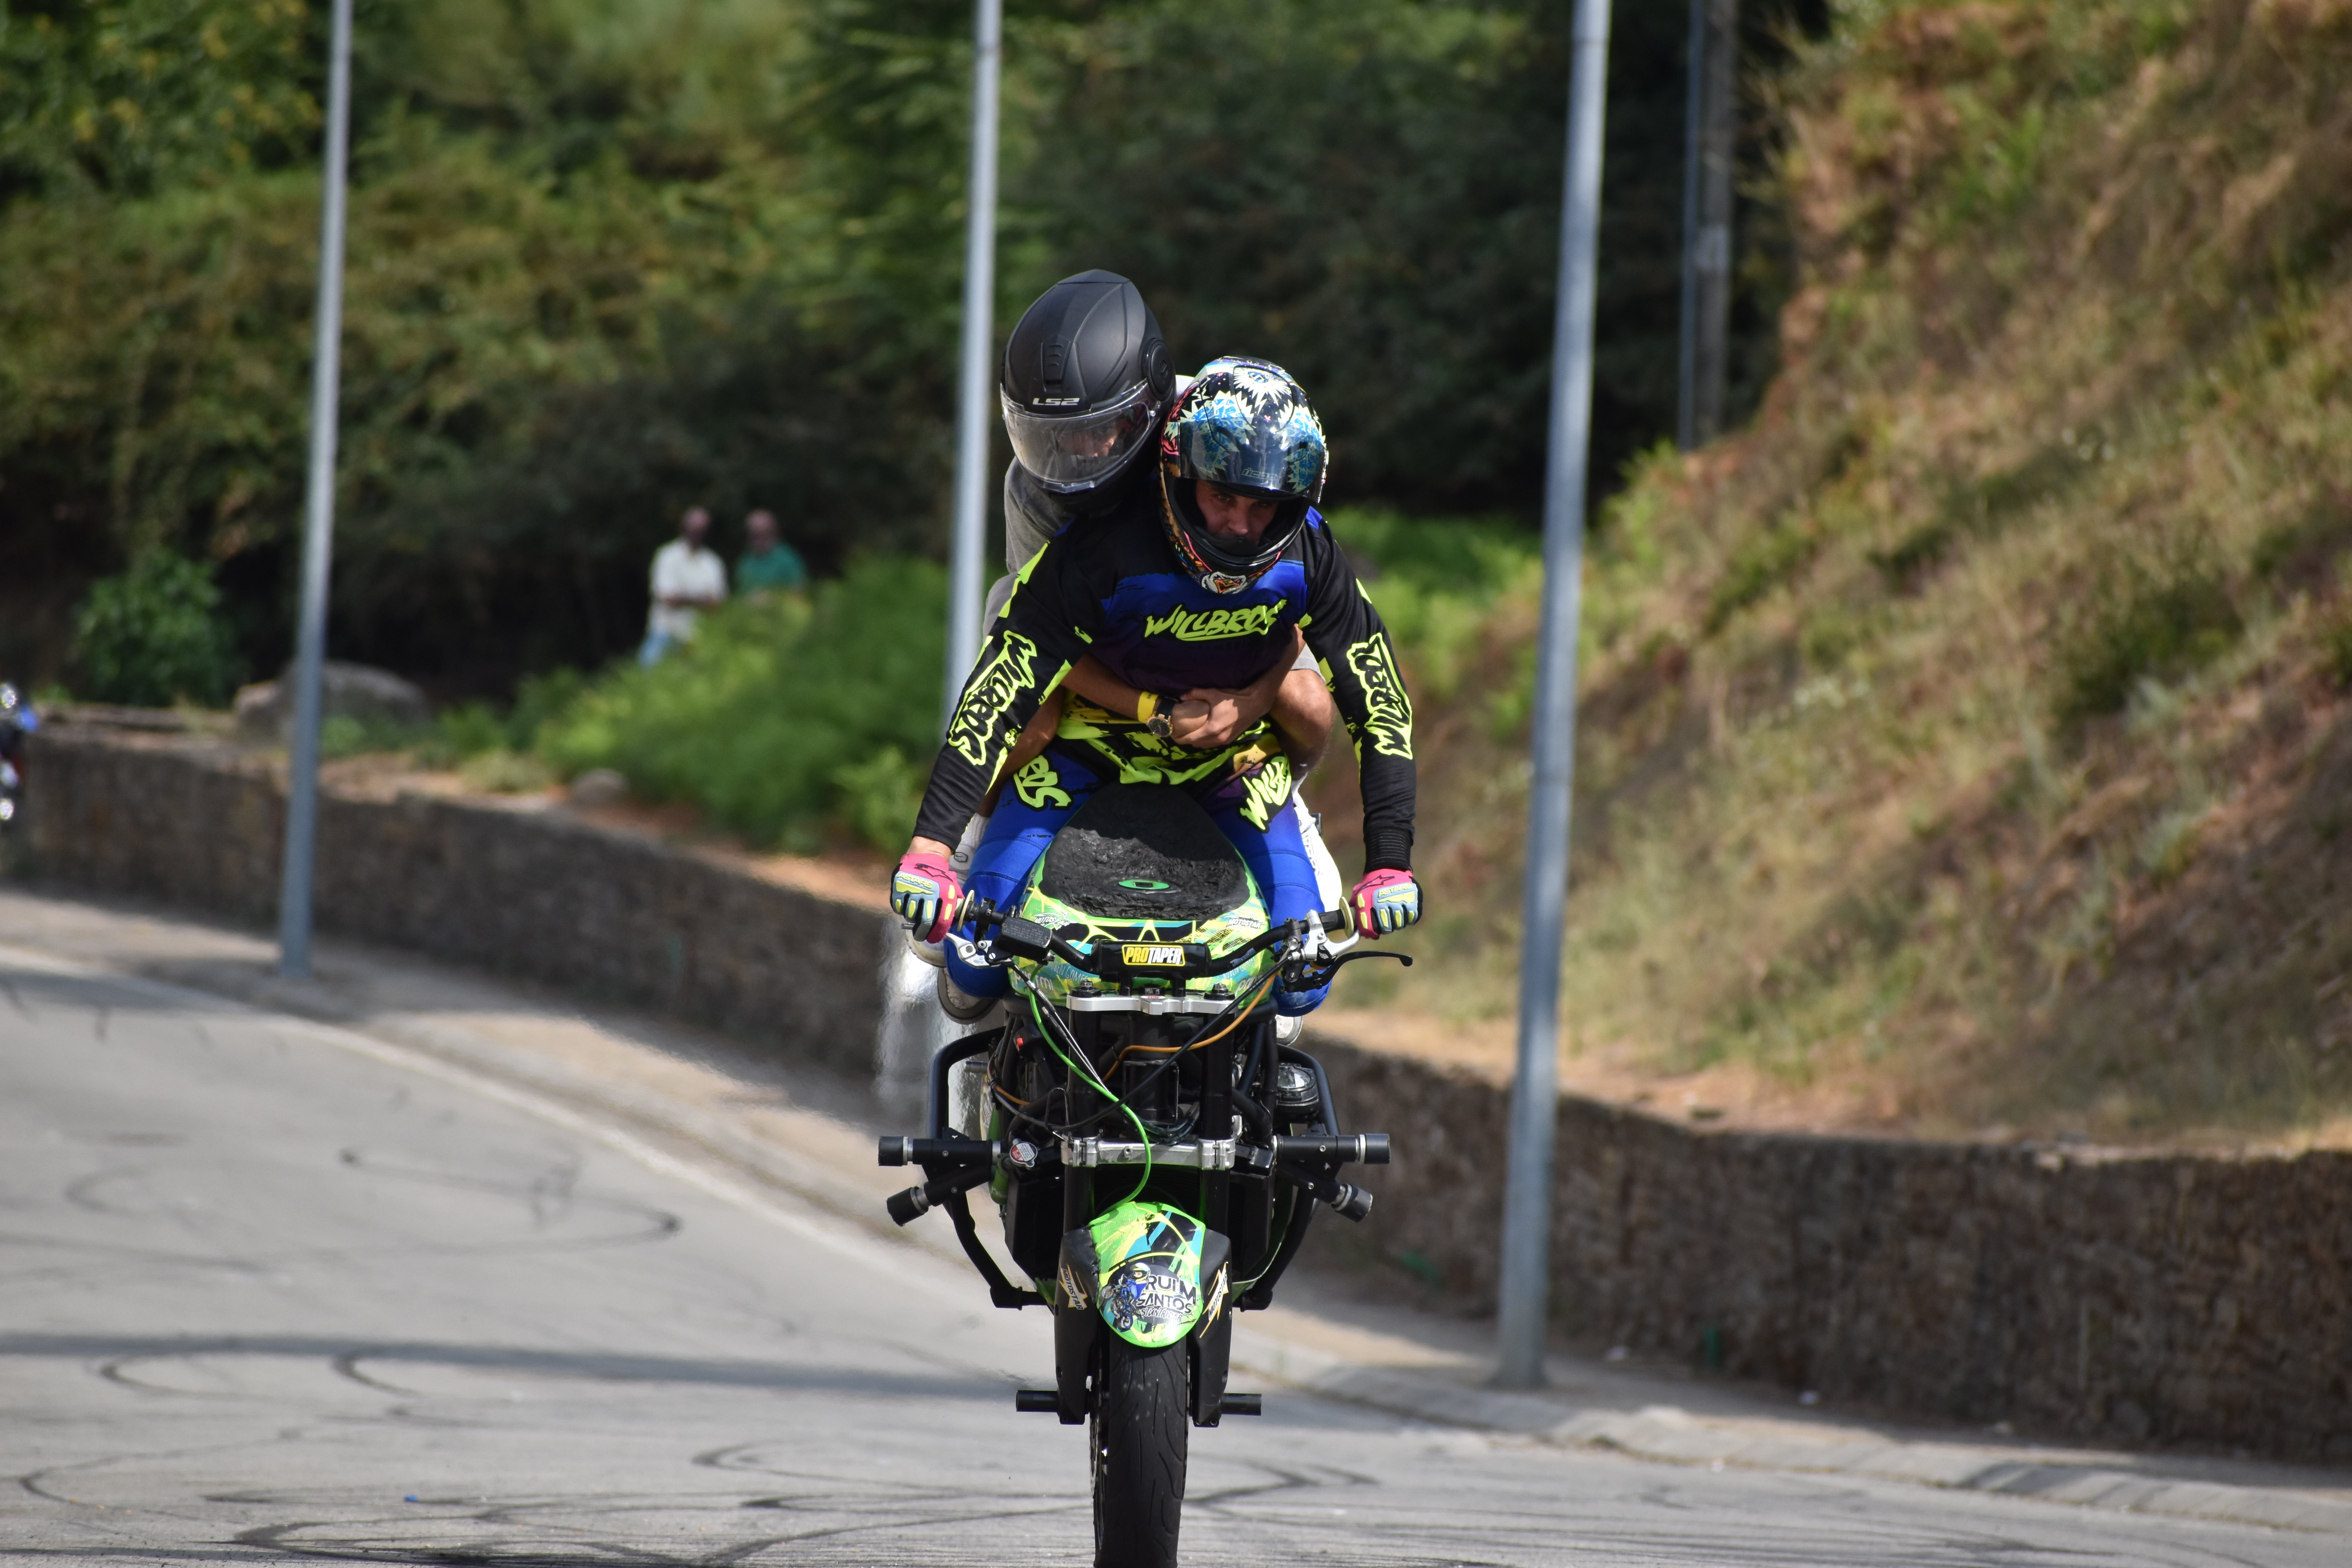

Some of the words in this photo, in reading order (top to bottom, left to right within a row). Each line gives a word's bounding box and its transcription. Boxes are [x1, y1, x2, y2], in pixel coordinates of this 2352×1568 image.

[897, 873, 933, 889] ASTARS
[1378, 883, 1412, 898] ASTARS
[1227, 918, 1261, 928] MOTOSTAR
[1125, 947, 1182, 965] PROTAPER
[1062, 1269, 1083, 1310] MOTOSTAR
[1209, 1272, 1228, 1319] MOTOSTAR
[1136, 1293, 1192, 1314] SANTOS
